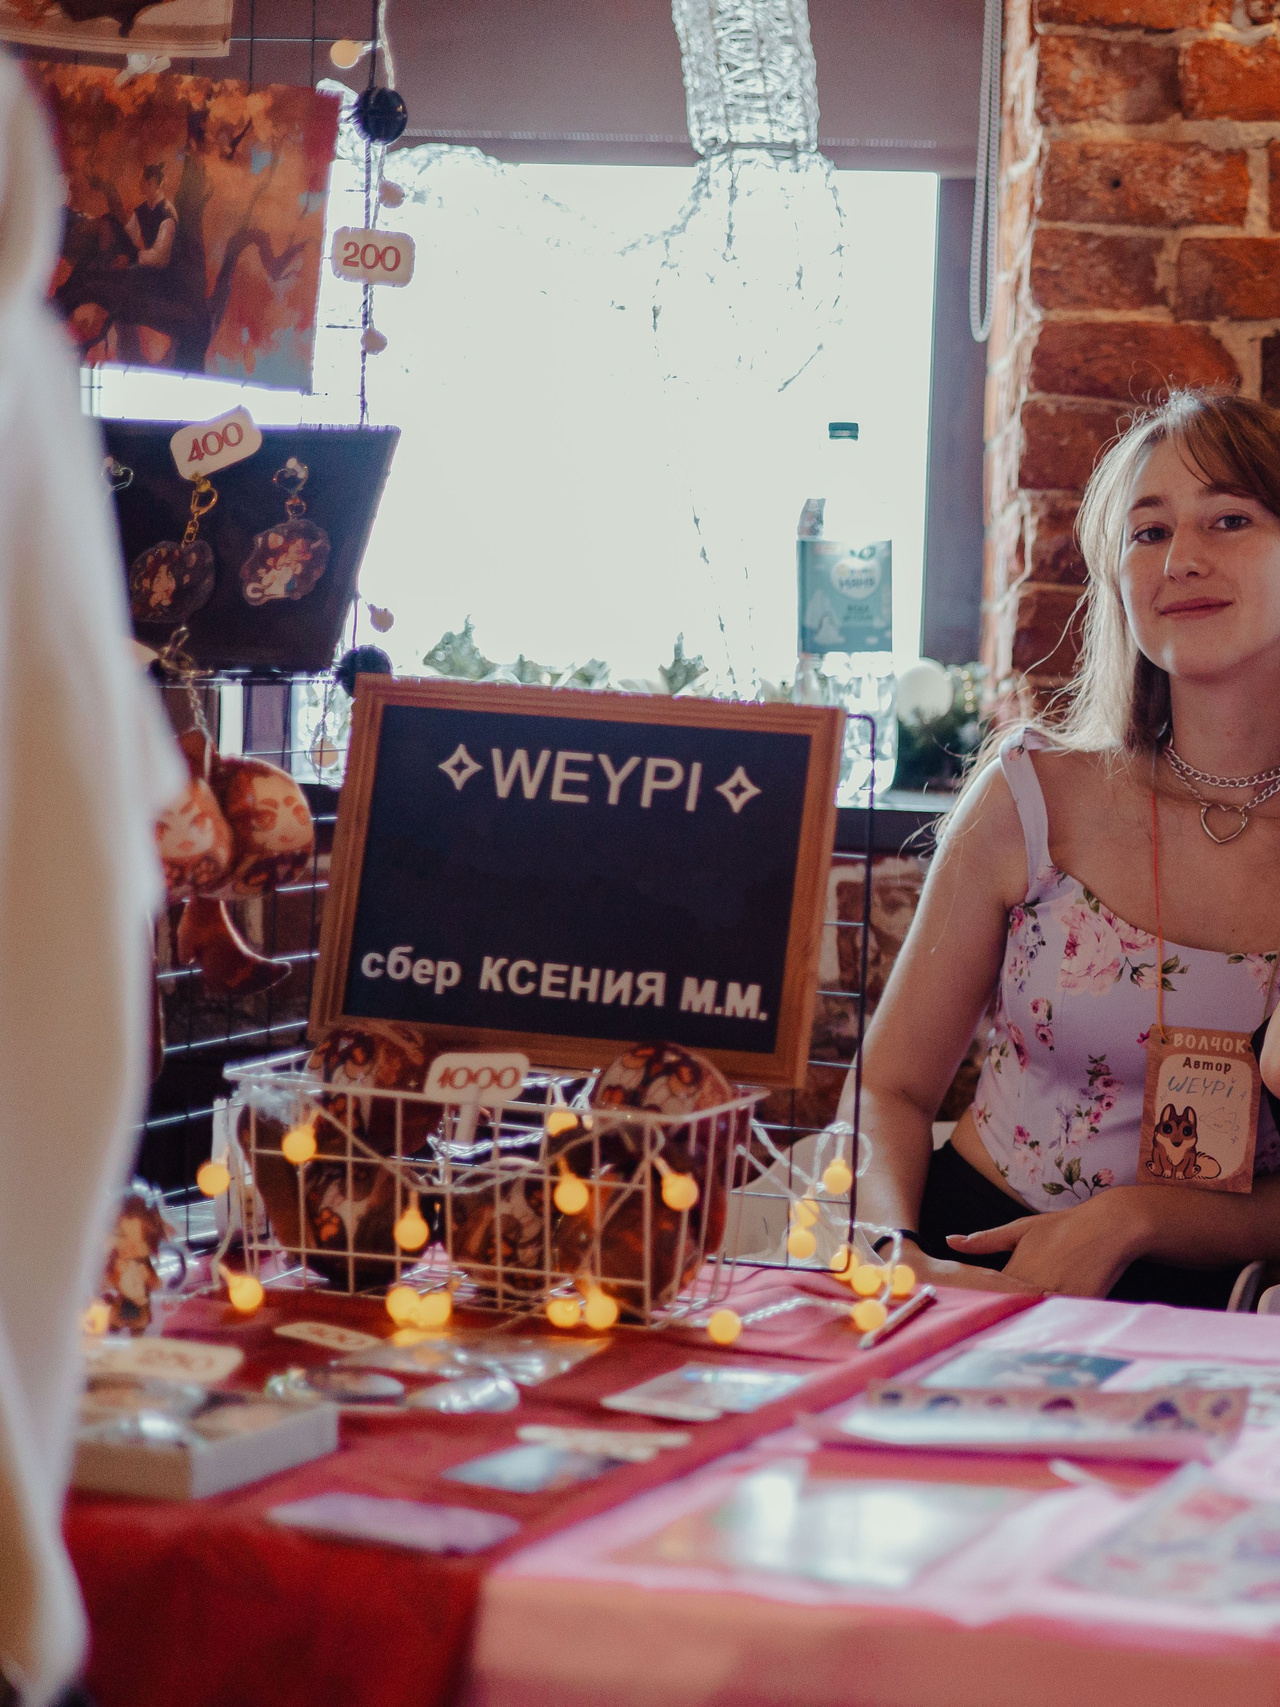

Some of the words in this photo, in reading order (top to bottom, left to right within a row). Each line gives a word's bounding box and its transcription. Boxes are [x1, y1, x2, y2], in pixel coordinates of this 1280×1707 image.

[342, 241, 402, 272] 200
[187, 422, 244, 463] 400
[490, 747, 703, 813] WEYPI
[360, 945, 462, 995] сбер
[479, 954, 668, 1007] КСЕНИЯ
[679, 976, 769, 1021] М.М.
[1172, 1033, 1246, 1054] ВОЛЧОК
[1182, 1057, 1232, 1074] Автор
